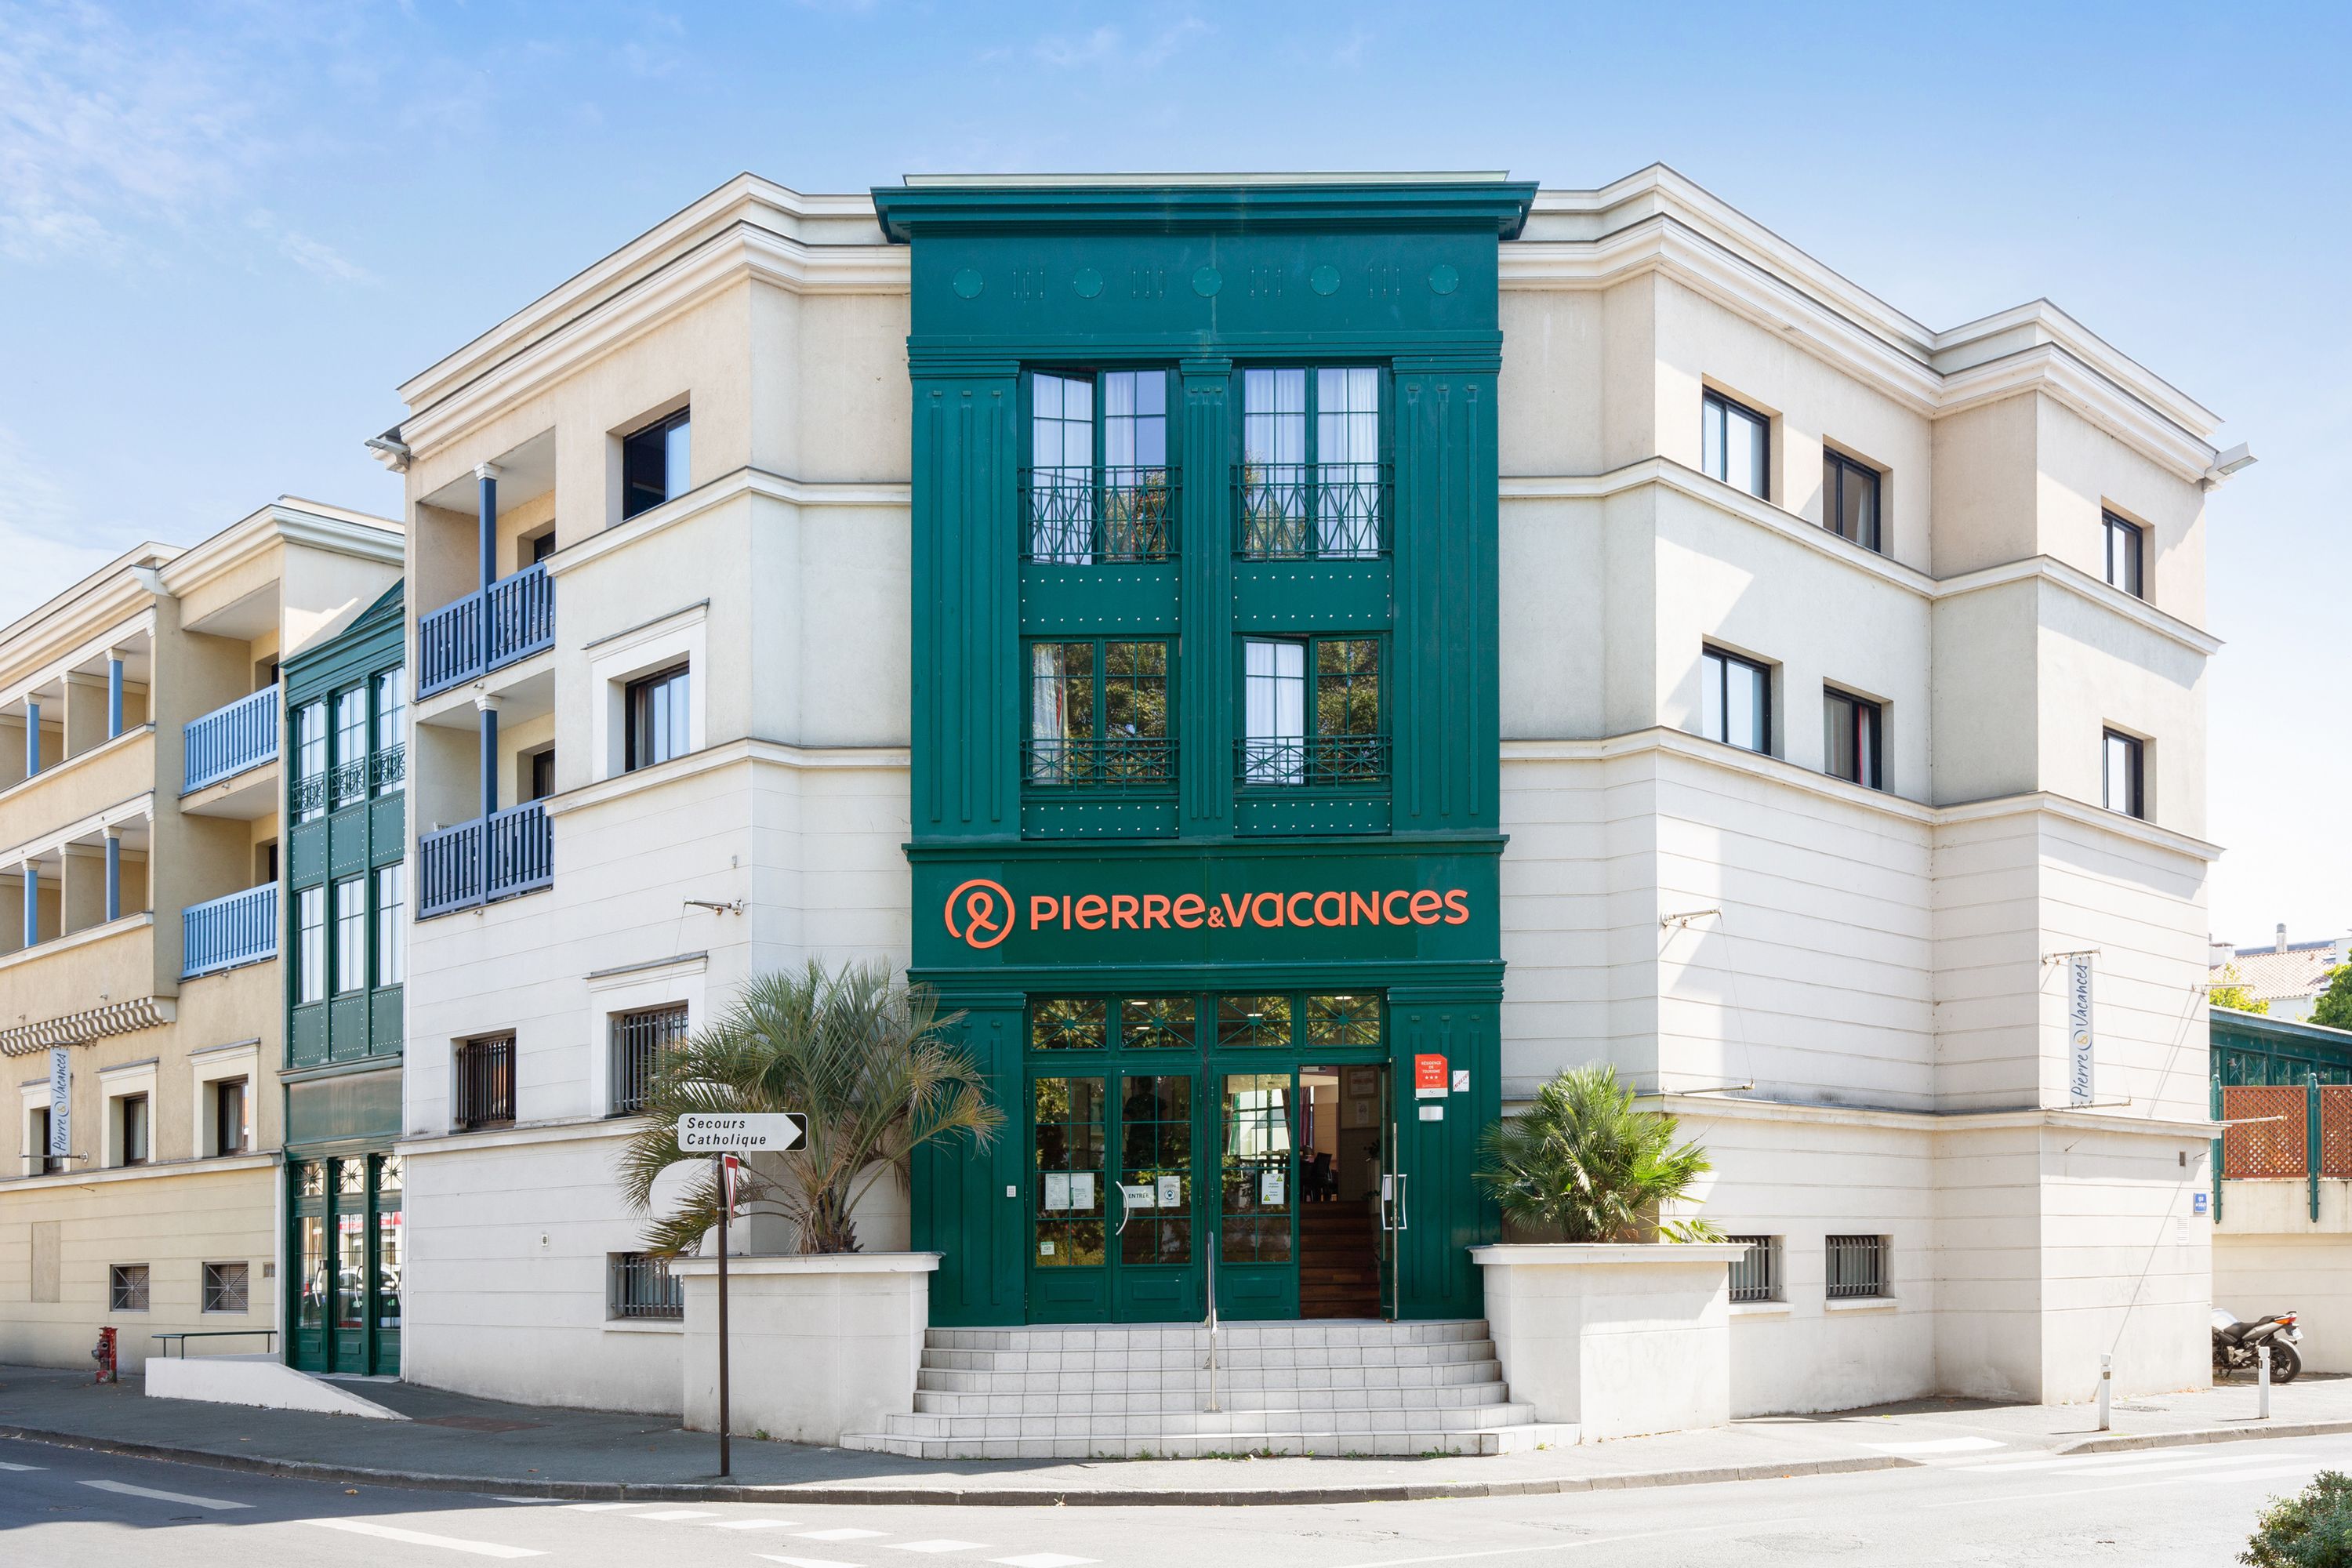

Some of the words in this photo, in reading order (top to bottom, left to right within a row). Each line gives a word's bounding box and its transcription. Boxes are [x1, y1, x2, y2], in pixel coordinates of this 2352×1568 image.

[2071, 964, 2089, 1027] Vacances
[52, 1053, 67, 1099] Vacances
[2071, 1054, 2089, 1098] Pierre
[52, 1119, 67, 1152] Pierre
[687, 1117, 746, 1129] Secours
[687, 1133, 766, 1148] Catholique
